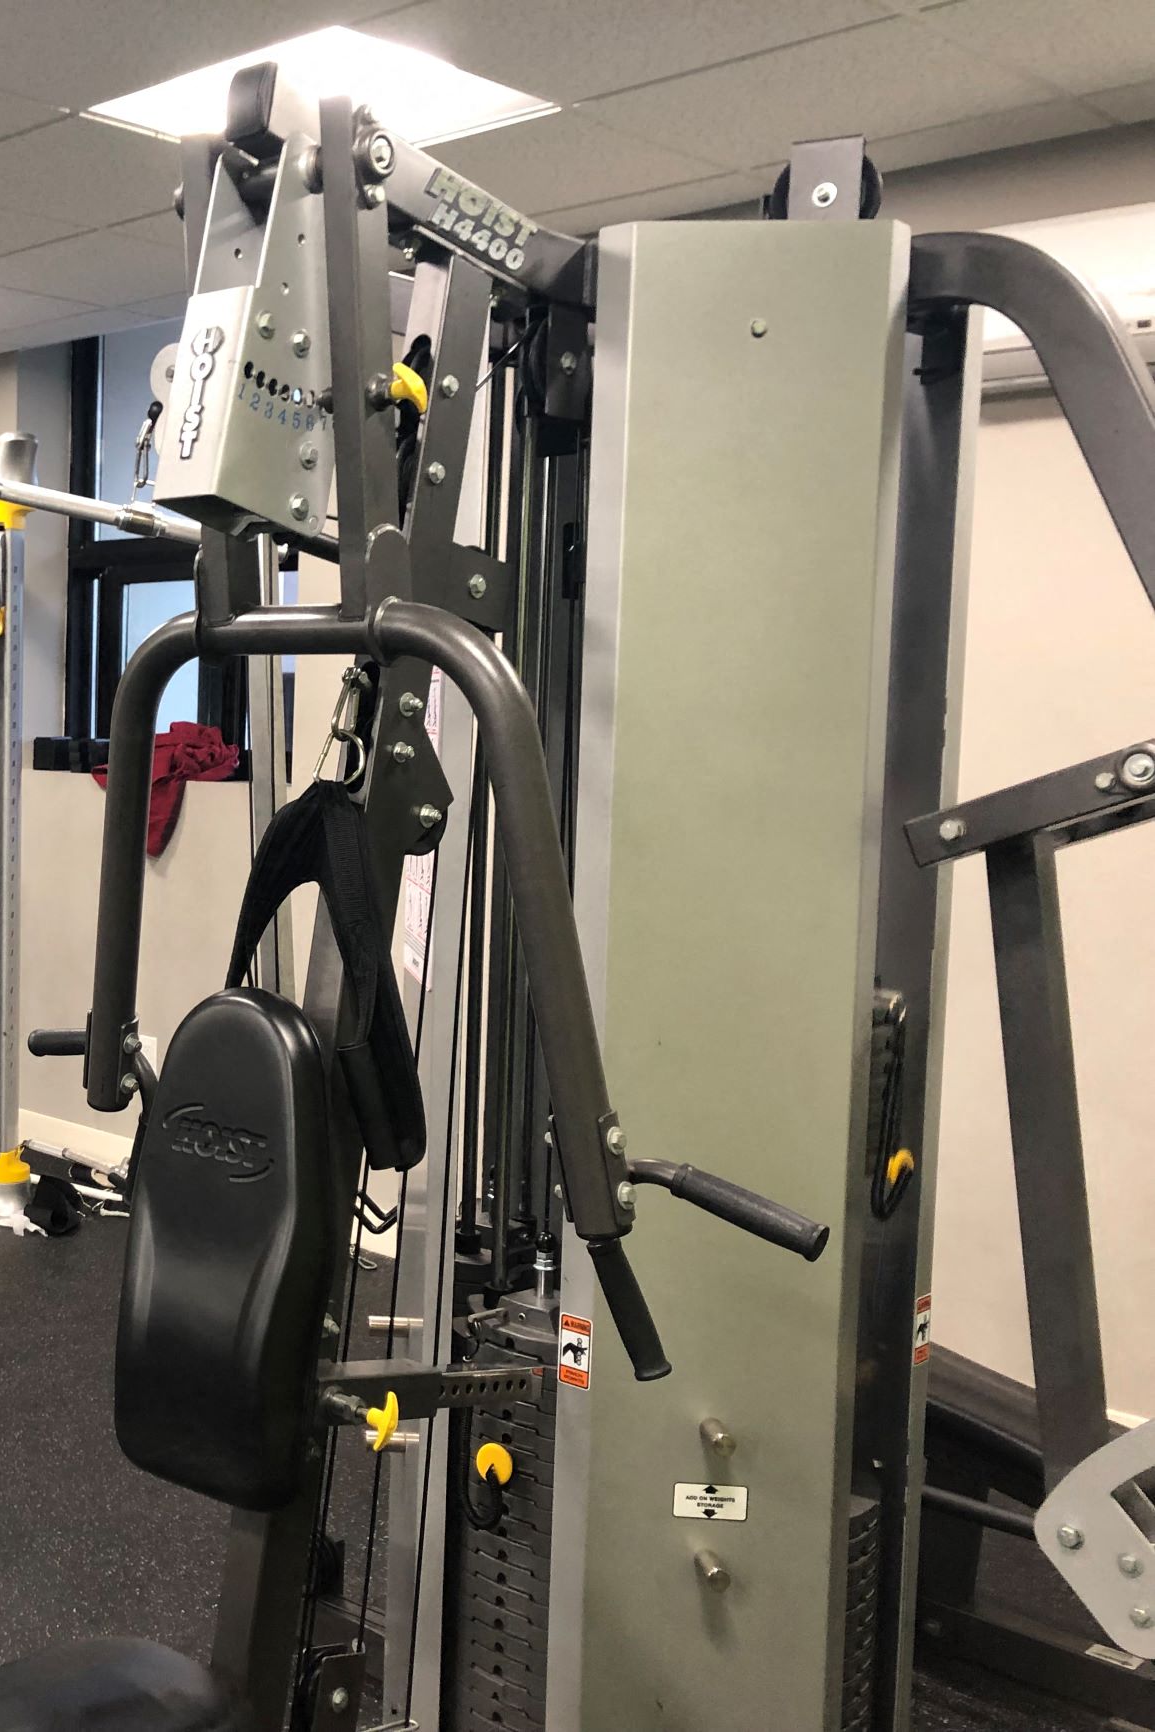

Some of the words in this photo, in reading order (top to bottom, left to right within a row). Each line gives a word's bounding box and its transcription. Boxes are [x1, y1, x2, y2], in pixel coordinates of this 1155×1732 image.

[425, 167, 538, 246] HOIST
[432, 202, 525, 270] H4400
[179, 326, 224, 459] HOIST
[250, 393, 261, 411] 2
[264, 405, 274, 419] 3
[277, 409, 287, 425] 4
[292, 412, 302, 430] 5
